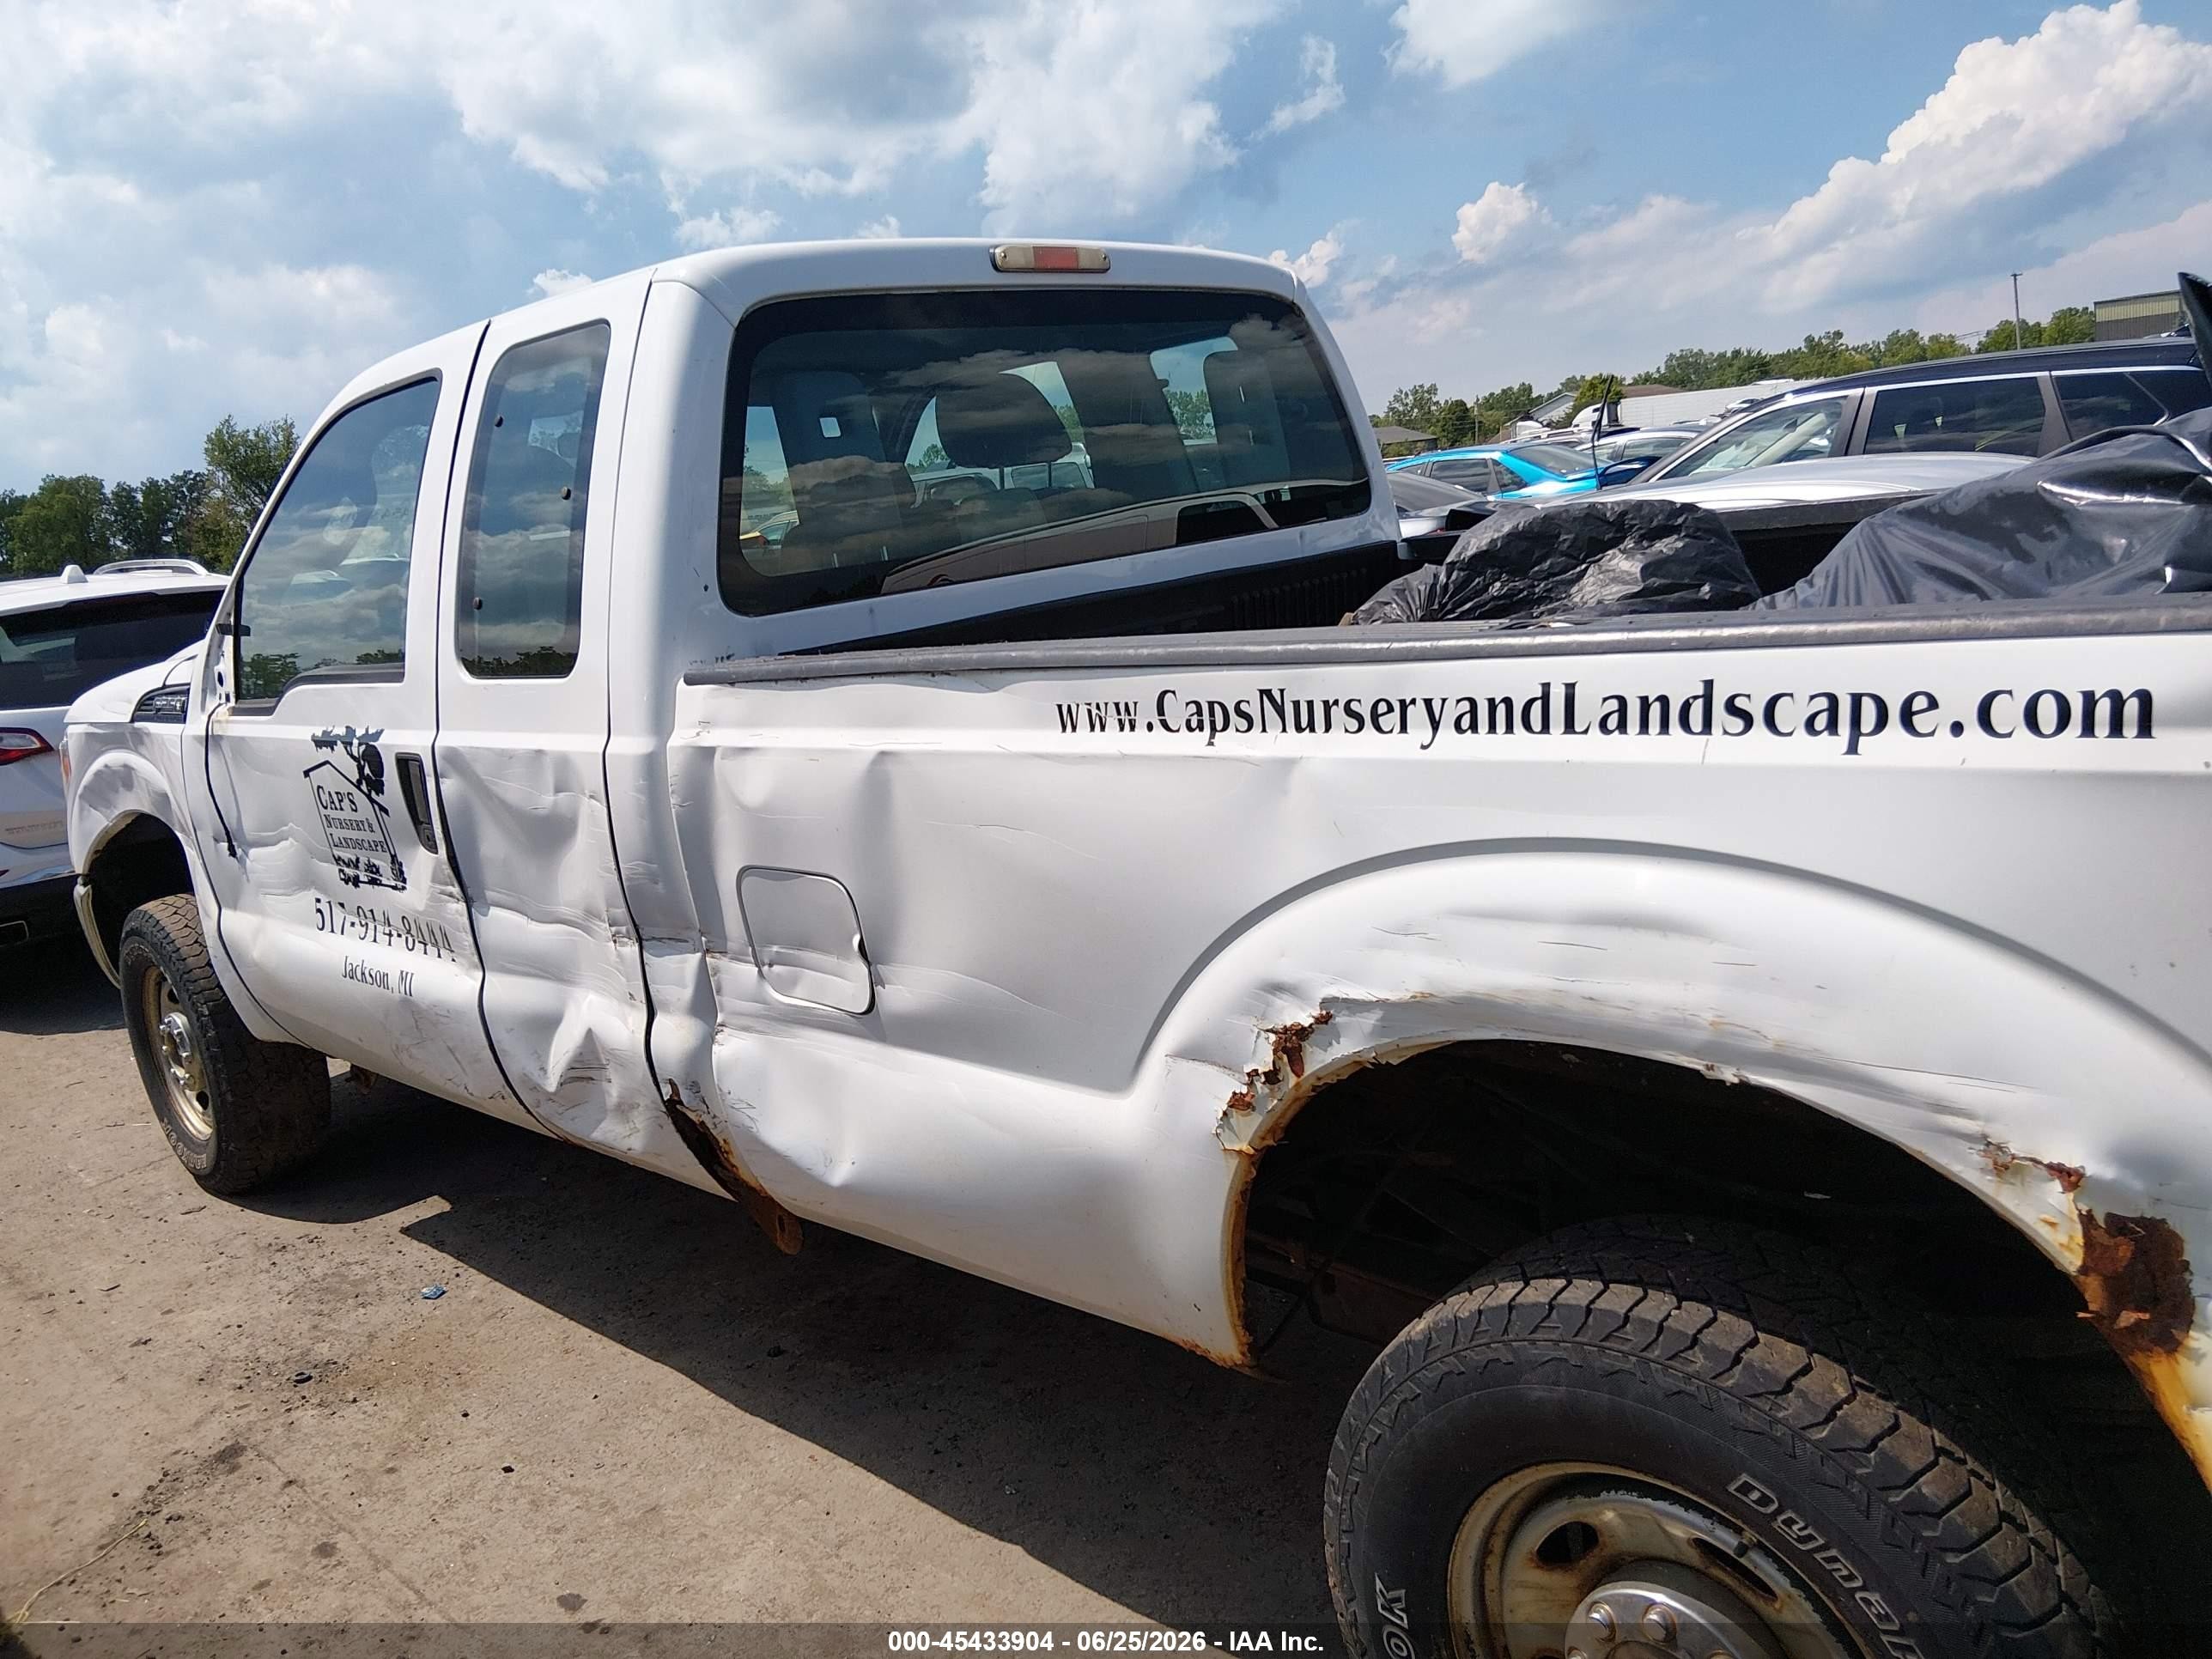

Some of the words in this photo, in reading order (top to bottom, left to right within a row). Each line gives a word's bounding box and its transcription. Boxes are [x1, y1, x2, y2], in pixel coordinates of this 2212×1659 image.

[1055, 679, 2154, 755] www.CapsNurseryandLandscape.com
[316, 785, 358, 813] CAP'S
[329, 833, 388, 854] LANDSCAPE
[314, 897, 457, 963] 517-914-8444
[342, 955, 394, 994] Jackson,
[398, 969, 415, 997] MI
